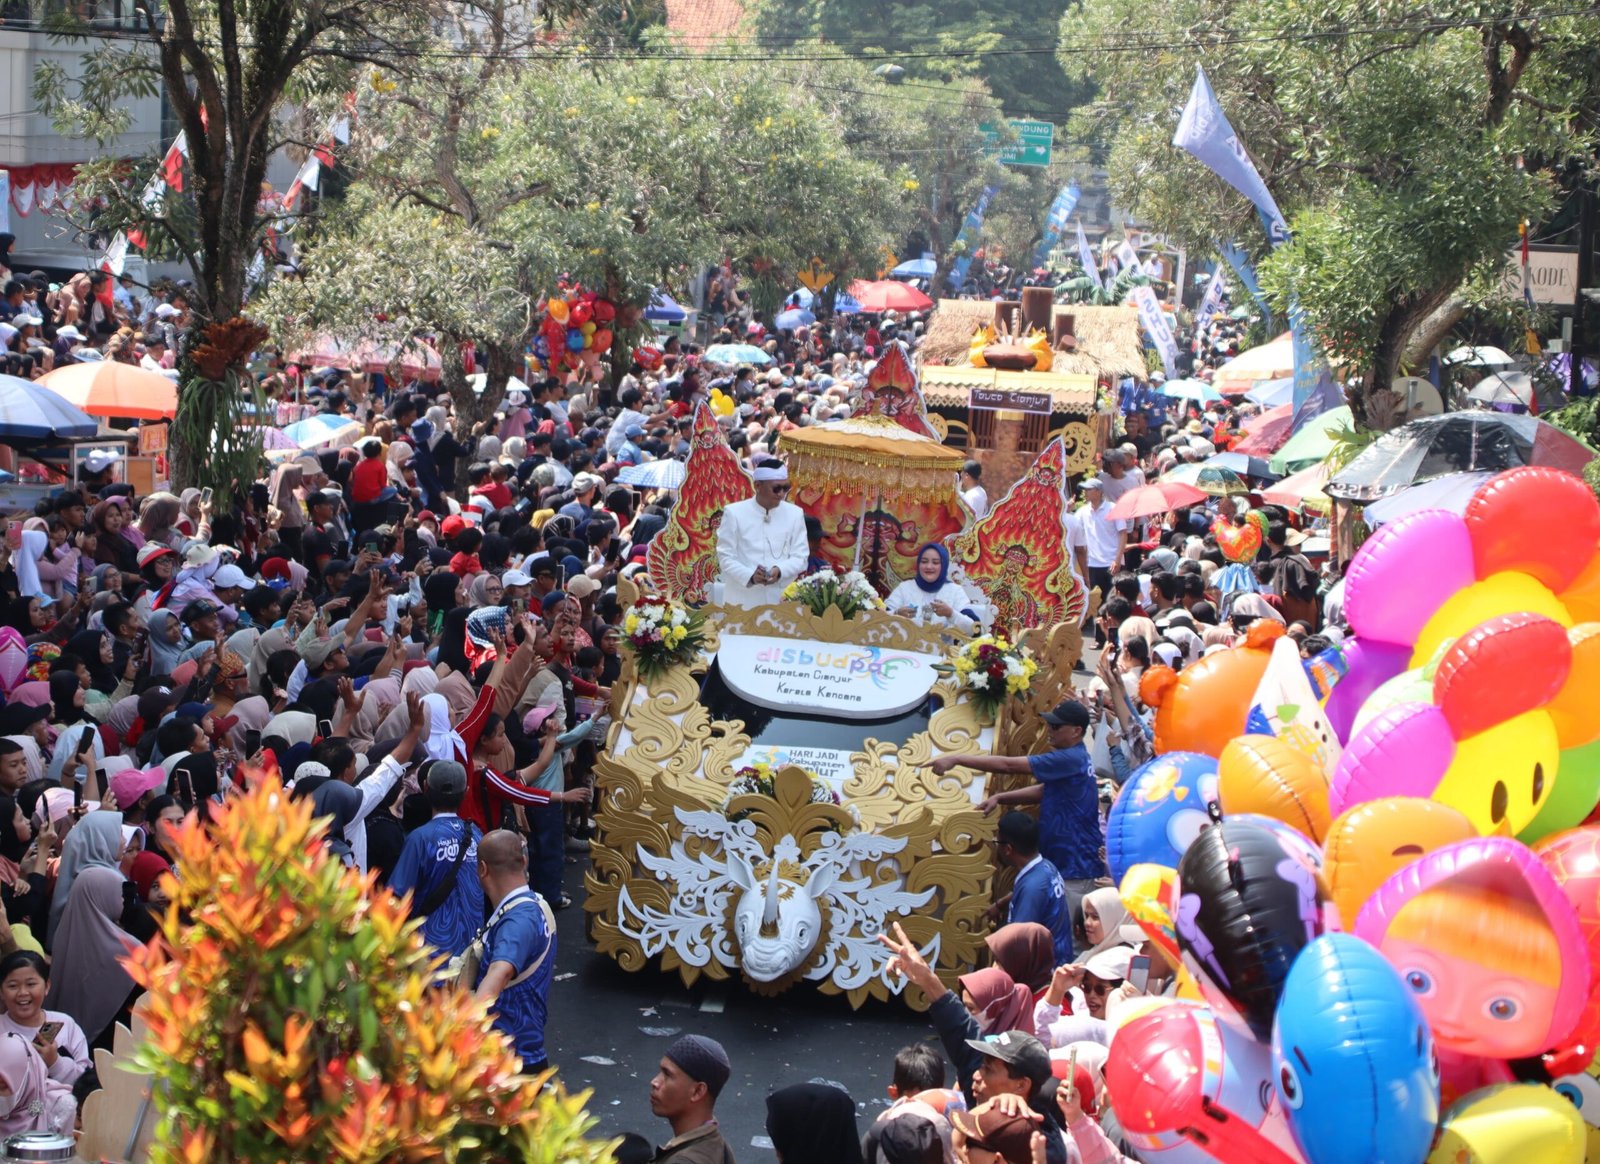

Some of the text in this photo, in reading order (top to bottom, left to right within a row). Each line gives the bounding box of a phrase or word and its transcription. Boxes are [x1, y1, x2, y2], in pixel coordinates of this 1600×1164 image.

[1010, 124, 1049, 134] NDUNG
[974, 389, 1048, 408] Tauco Cianjur
[756, 646, 899, 678] disbudpar
[754, 664, 853, 684] Kabupaten Cianjur
[817, 685, 863, 703] Kencana
[789, 749, 813, 758] HARI
[815, 751, 839, 761] JADI
[787, 757, 845, 769] Kabupaten
[804, 766, 839, 778] njur
